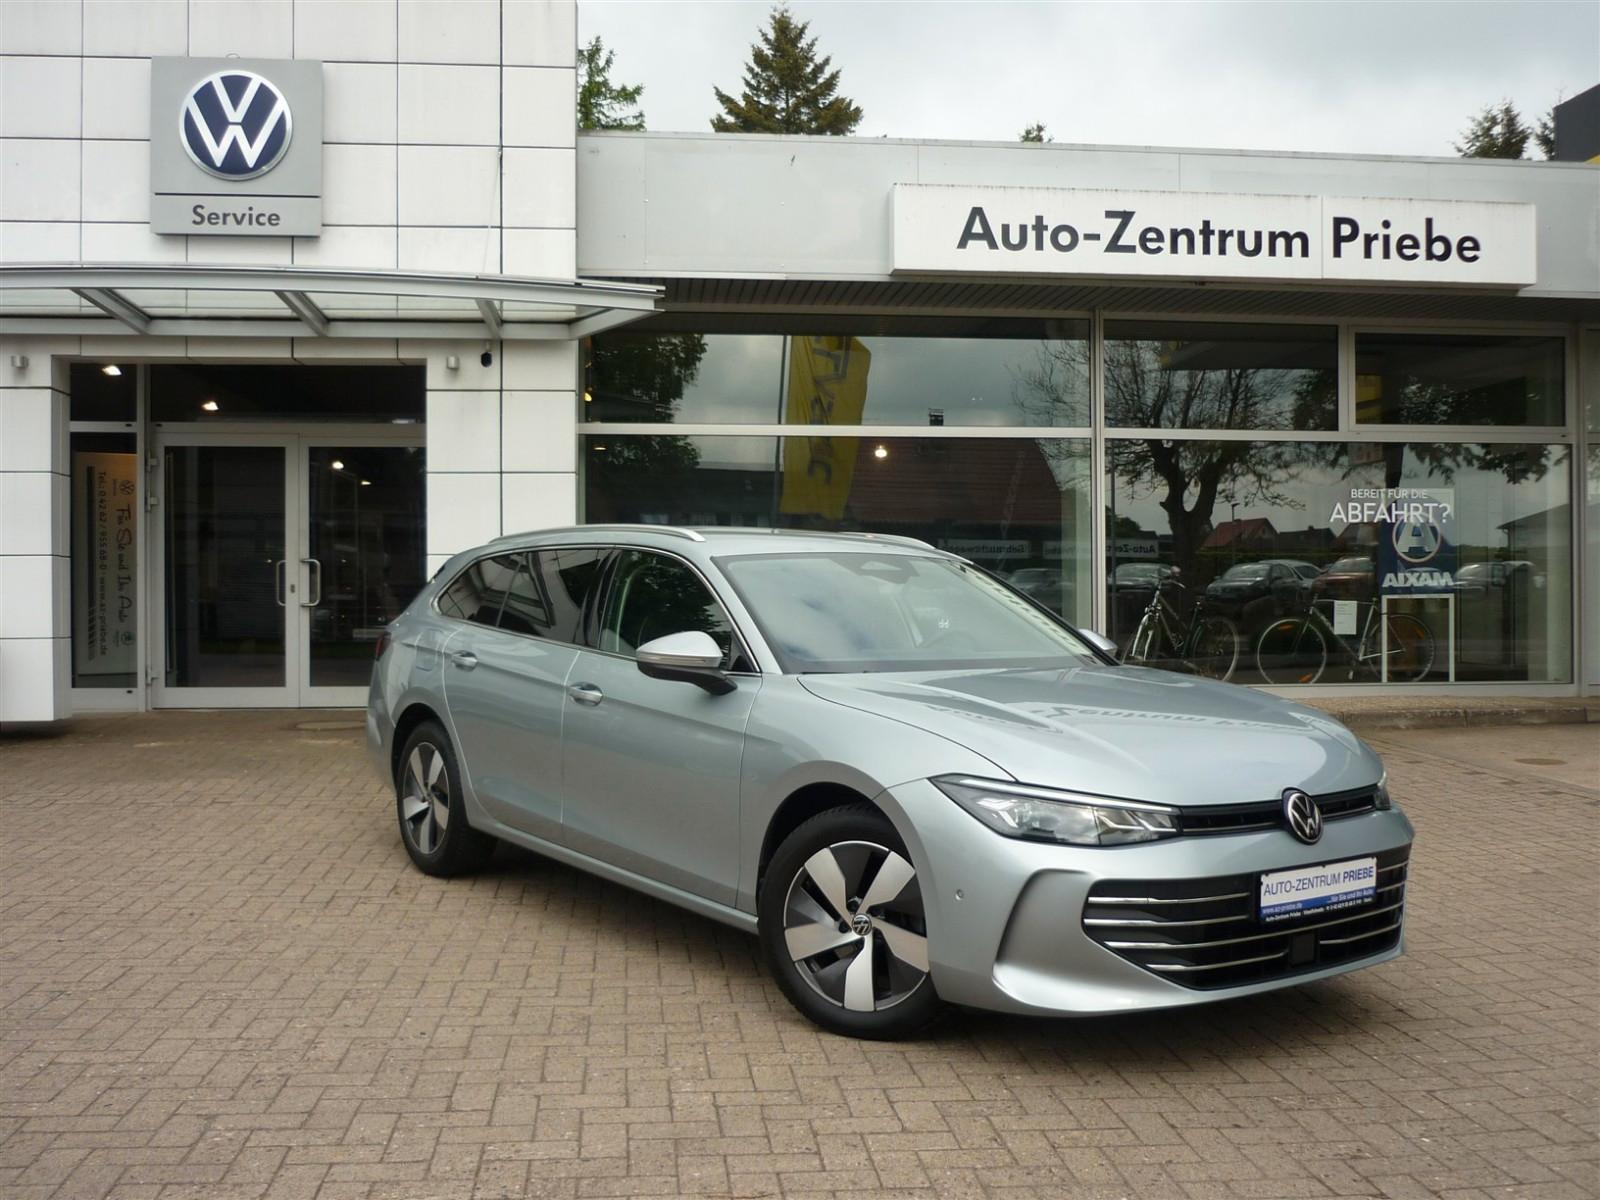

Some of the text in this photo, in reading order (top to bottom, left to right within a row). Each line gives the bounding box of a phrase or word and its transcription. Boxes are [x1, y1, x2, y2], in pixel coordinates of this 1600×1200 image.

[179, 70, 293, 181] VW
[191, 204, 281, 226] Service
[956, 205, 1482, 263] Auto-Zentrum Priebe
[1350, 486, 1429, 499] BEREIT FÜR DIE
[1329, 502, 1451, 524] ABFAHRT?
[1381, 571, 1455, 588] AIXAM
[1287, 792, 1320, 843] VW
[1263, 866, 1375, 897] AUTO-ZENTRUM PRIEBE
